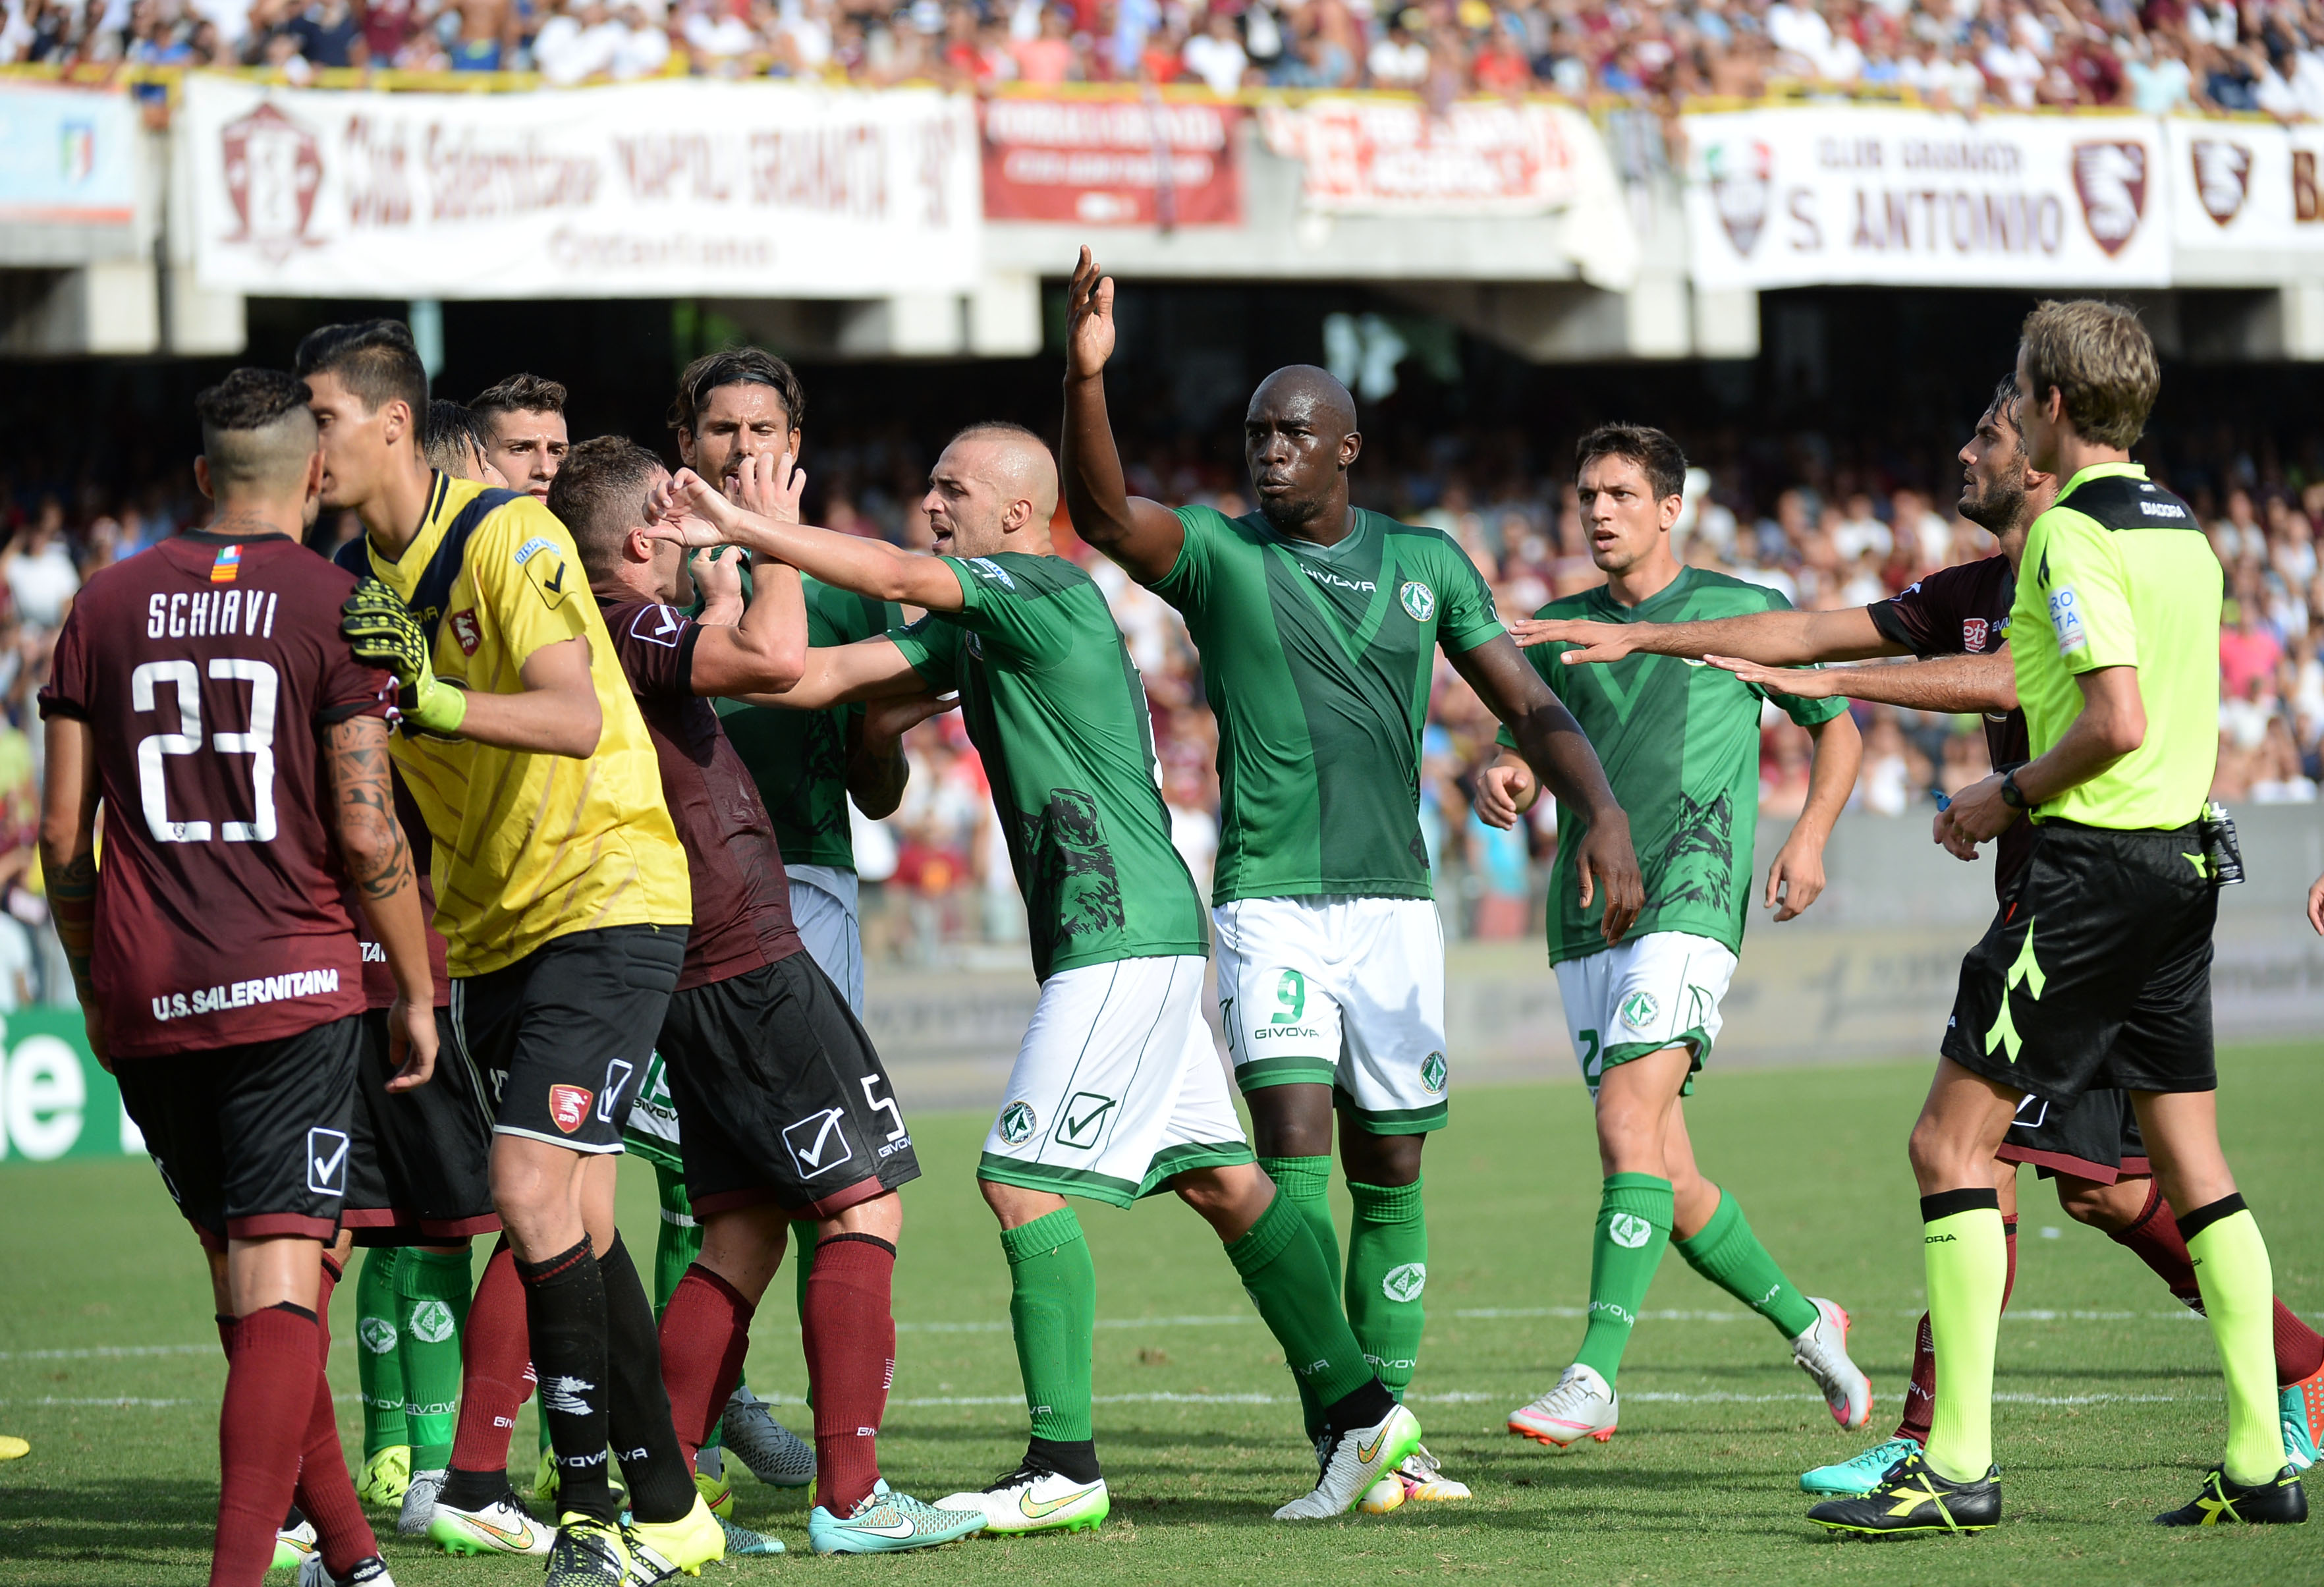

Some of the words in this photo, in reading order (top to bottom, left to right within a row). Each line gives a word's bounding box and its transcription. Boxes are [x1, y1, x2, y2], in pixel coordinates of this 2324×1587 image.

[1851, 187, 2064, 254] ANTONIO
[148, 590, 277, 639] SCHIAVI
[132, 658, 278, 843] 23
[1271, 970, 1305, 1024] 9
[1254, 1027, 1319, 1040] GIVOVA
[632, 1098, 679, 1121] GIVOV
[860, 1073, 906, 1142] 5
